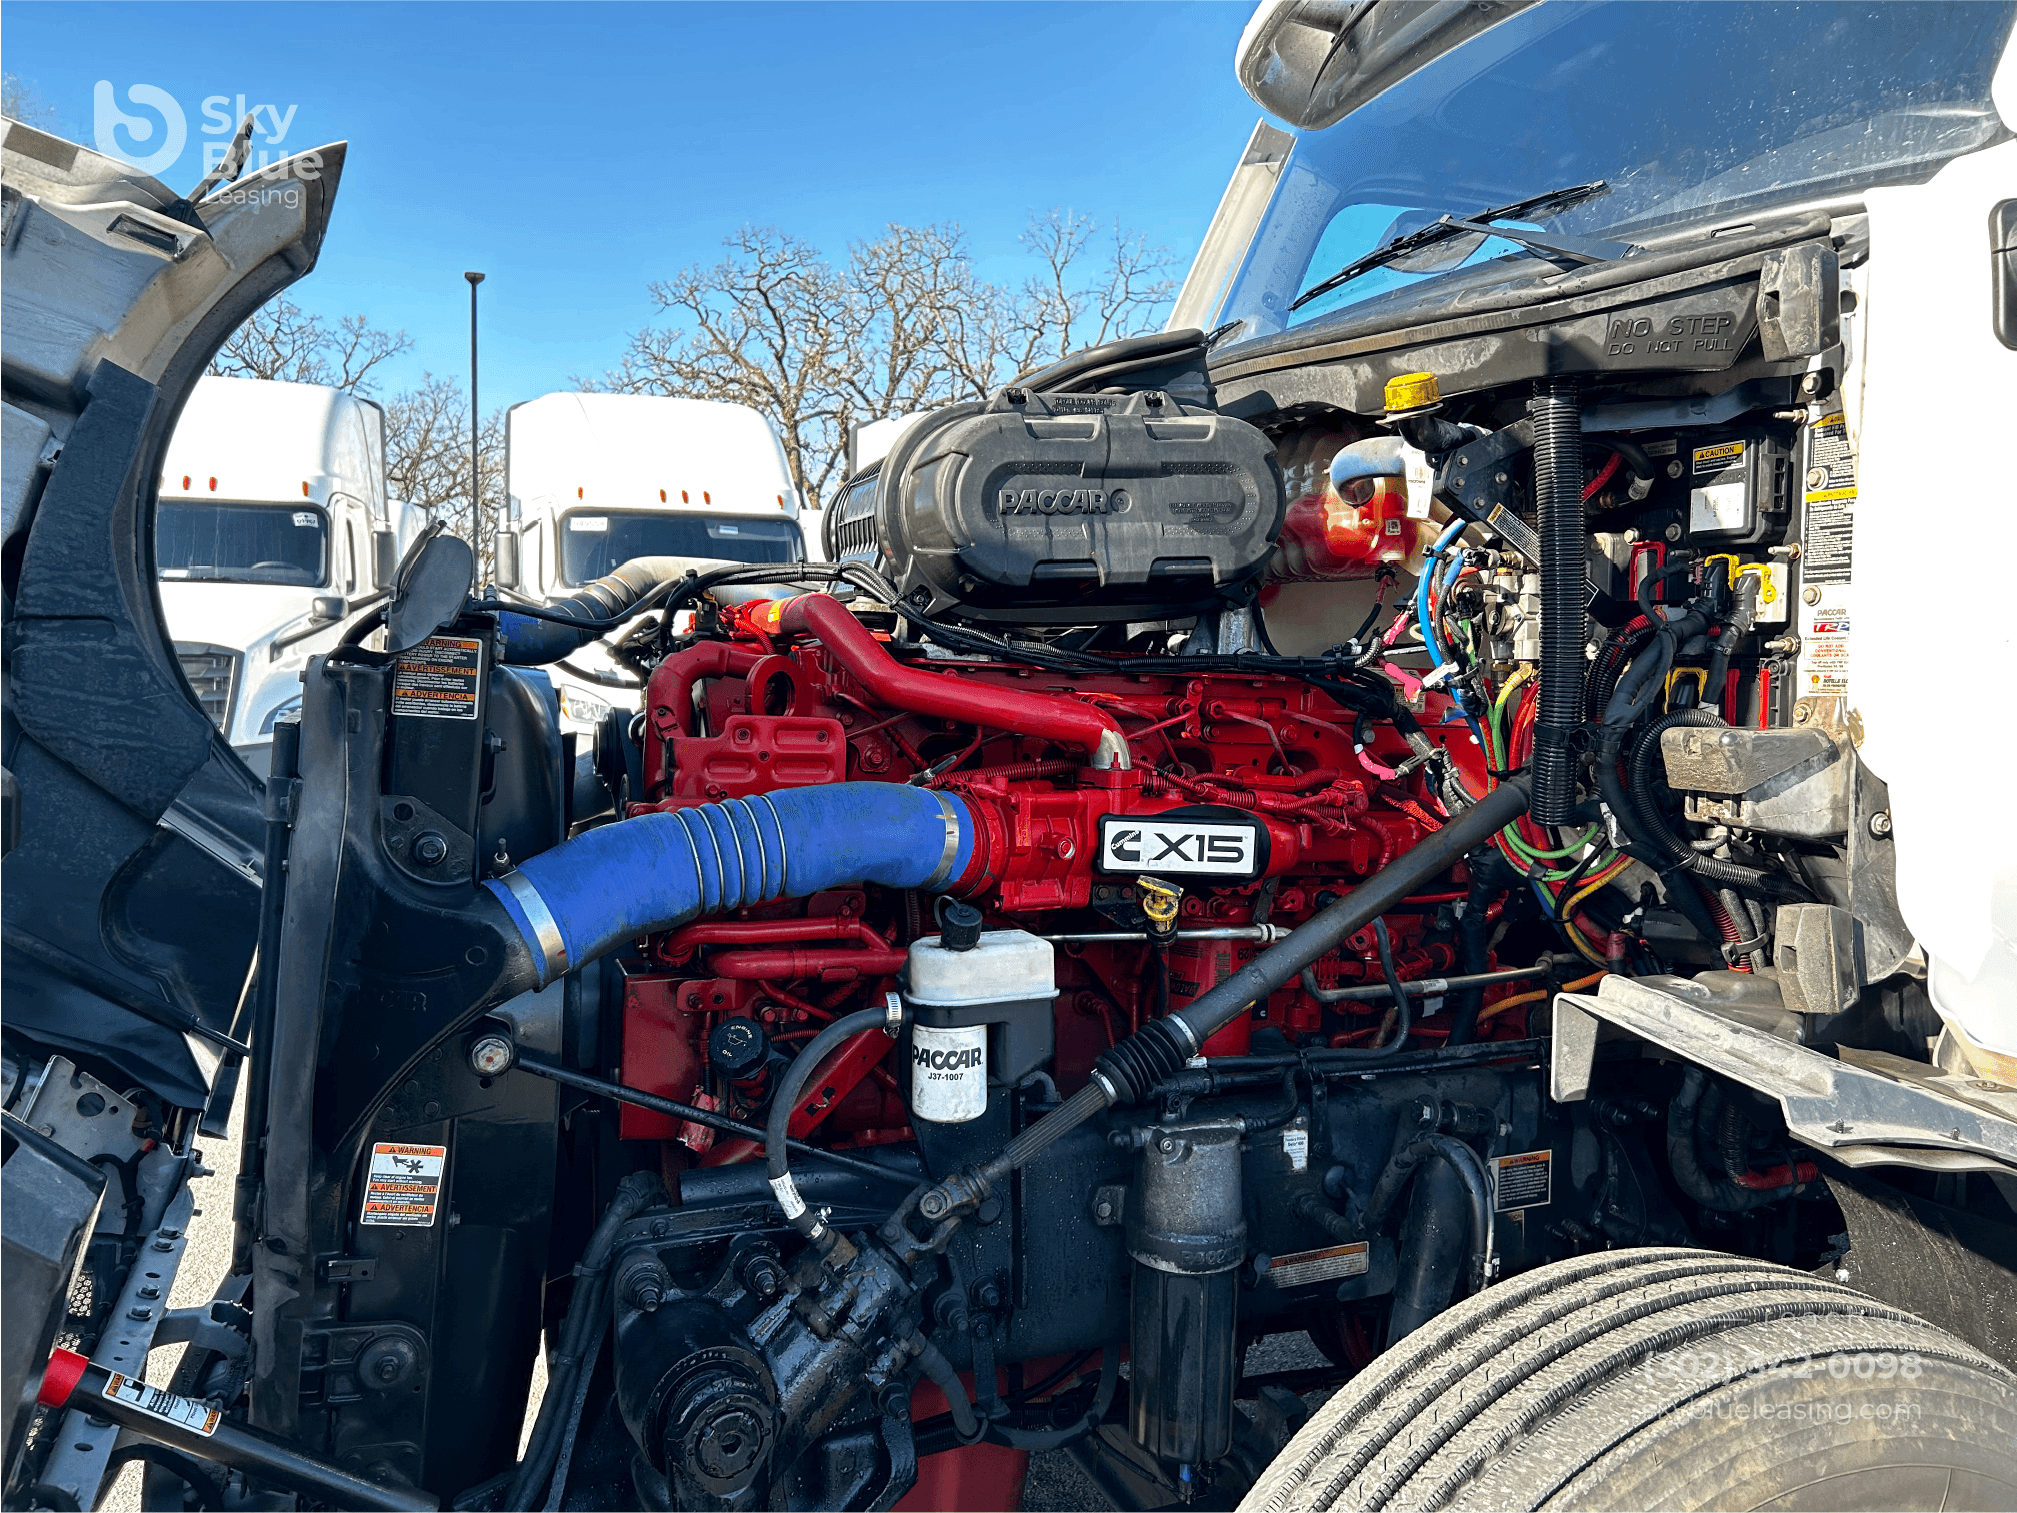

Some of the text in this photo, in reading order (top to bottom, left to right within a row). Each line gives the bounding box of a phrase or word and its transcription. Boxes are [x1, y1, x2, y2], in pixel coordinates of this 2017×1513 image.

[1612, 316, 1731, 338] NO STEP
[1608, 338, 1733, 356] DO NOT PULL
[1705, 446, 1734, 457] CAUTION
[998, 489, 1108, 514] PACCAR
[407, 665, 474, 675] AVERTISSEMENT
[411, 691, 468, 700] ADVERTENCIA
[1152, 832, 1244, 863] X15
[731, 1024, 753, 1039] ENGINE
[722, 1049, 732, 1057] OIL
[912, 1043, 982, 1071] PACCAR
[927, 1072, 964, 1081] J37-1007
[398, 1146, 431, 1155] WARNING
[380, 1184, 436, 1193] AVERTISSEMENT
[380, 1204, 429, 1213] ADVERTENCIA
